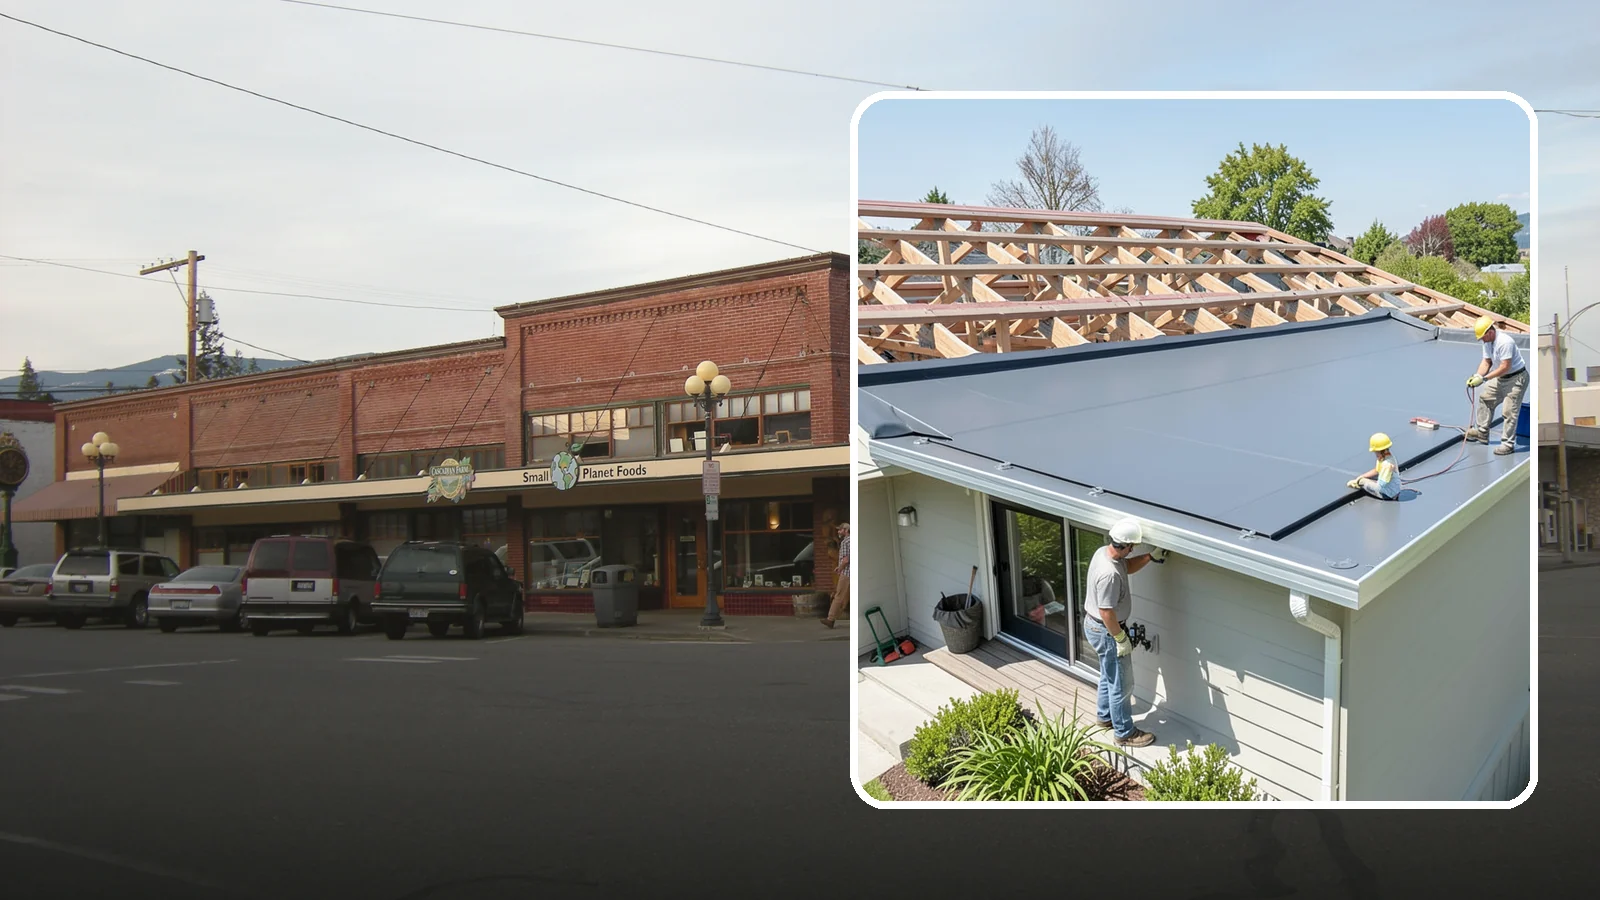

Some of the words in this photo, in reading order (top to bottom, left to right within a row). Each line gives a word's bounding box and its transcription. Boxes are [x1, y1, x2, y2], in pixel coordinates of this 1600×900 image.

[523, 471, 548, 482] Small
[583, 467, 613, 479] Planet
[617, 465, 646, 476] Foods
